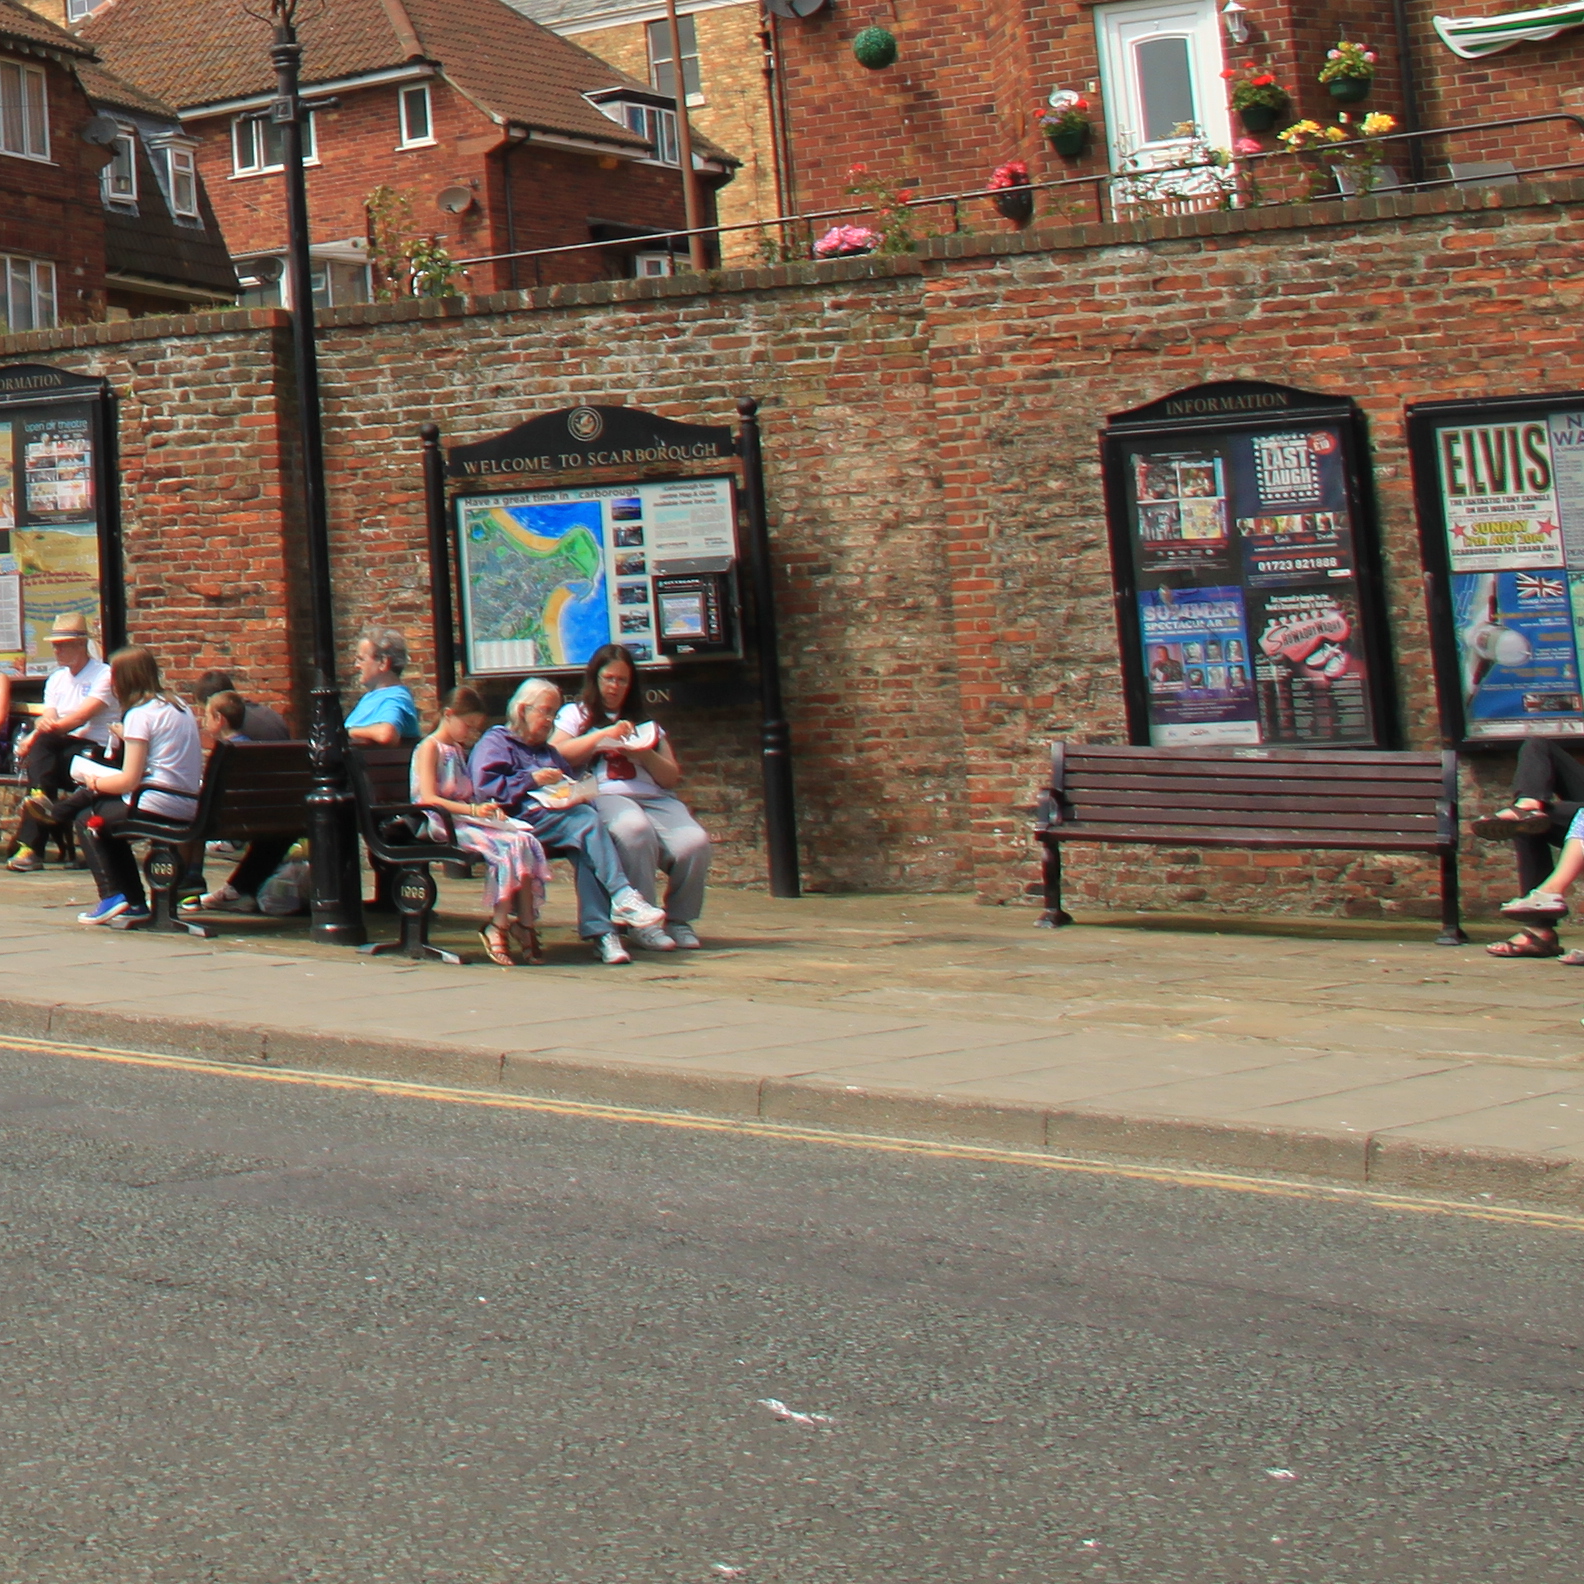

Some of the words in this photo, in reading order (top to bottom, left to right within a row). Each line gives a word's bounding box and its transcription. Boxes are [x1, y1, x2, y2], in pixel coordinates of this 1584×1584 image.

[1165, 393, 1288, 415] INFORMATION
[463, 456, 550, 474] WELCOME
[558, 453, 582, 467] TO
[587, 442, 718, 465] SCARBOROUGH
[1261, 446, 1307, 470] LAST
[1441, 424, 1552, 497] ELVIS
[1264, 467, 1312, 486] LAUGH
[465, 496, 489, 506] Have
[503, 495, 530, 506] great
[532, 493, 556, 502] time
[559, 492, 569, 500] in
[1471, 520, 1529, 535] SUNDAY
[1490, 535, 1515, 546] AUG
[1258, 560, 1292, 572] 01723
[1295, 557, 1338, 569] 821888
